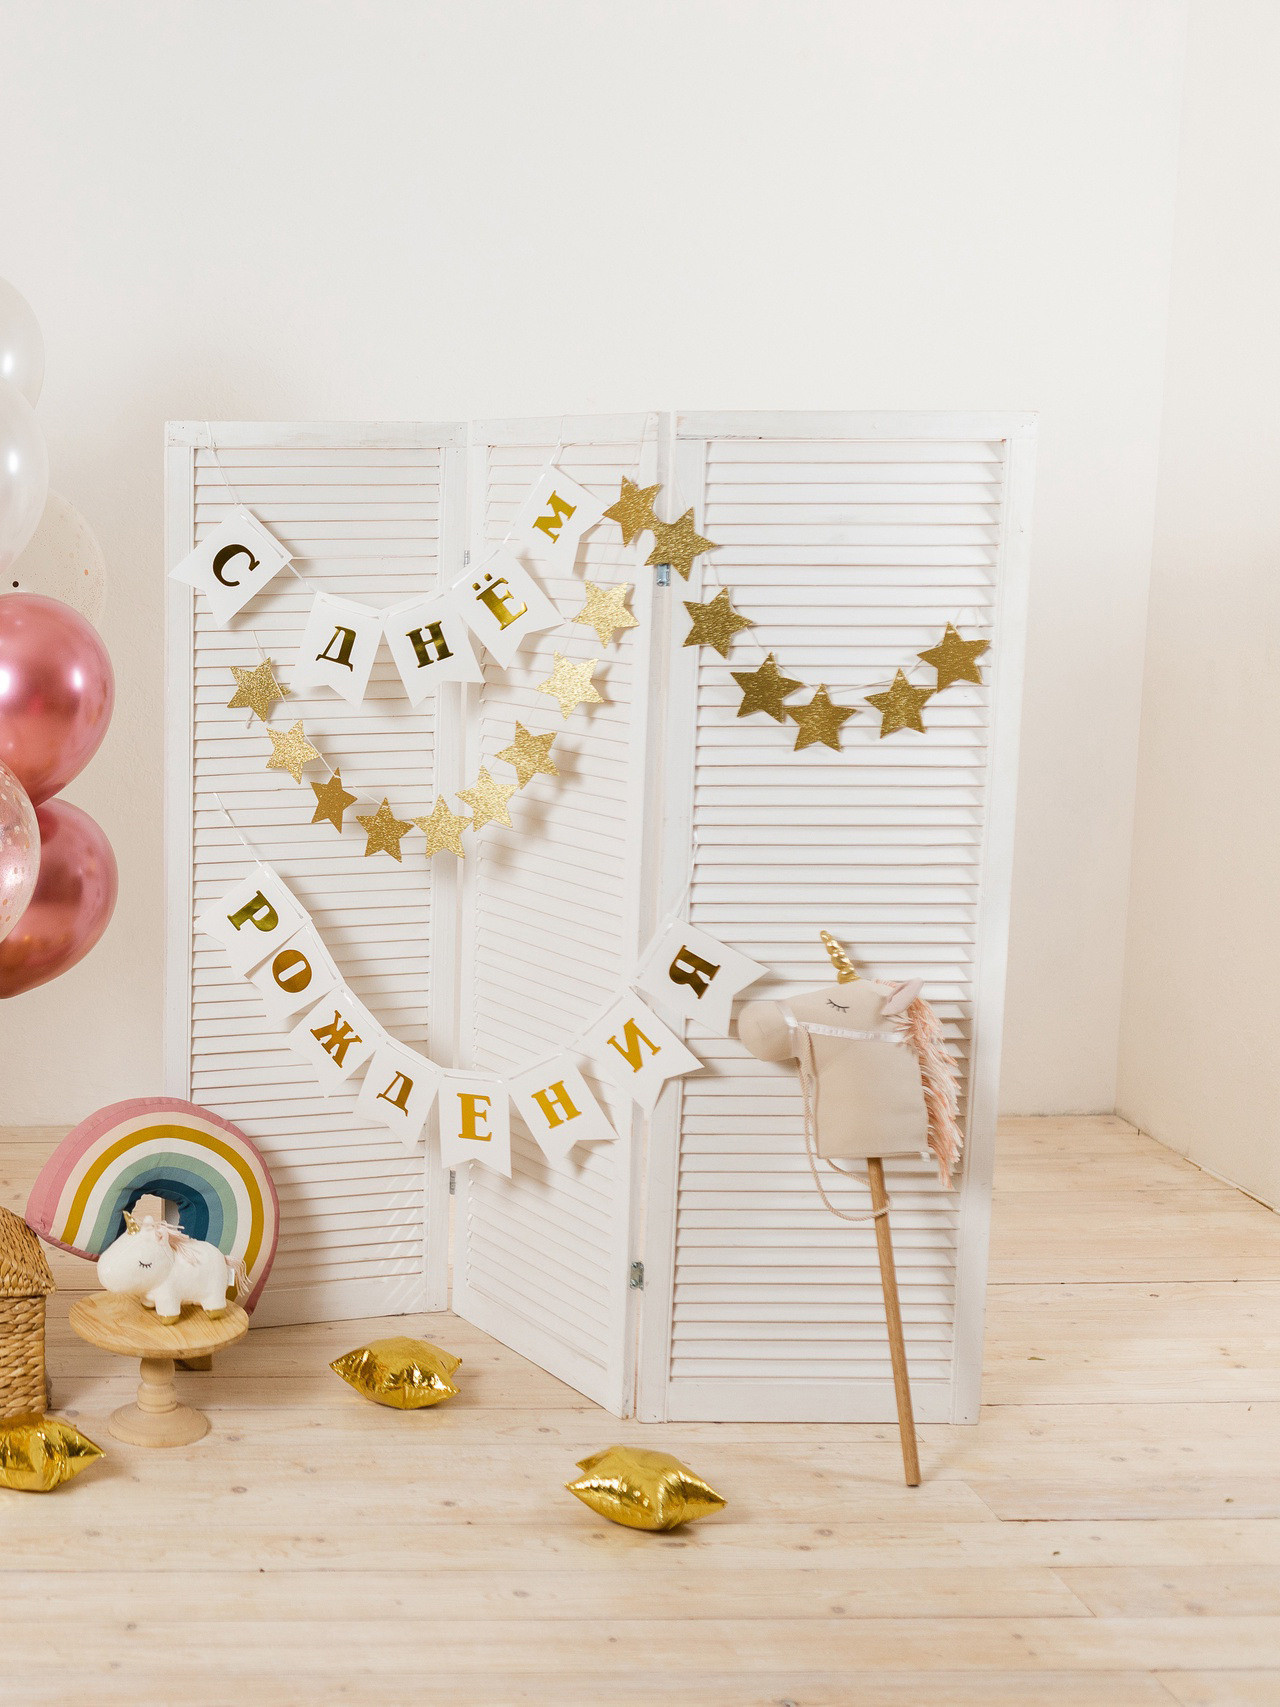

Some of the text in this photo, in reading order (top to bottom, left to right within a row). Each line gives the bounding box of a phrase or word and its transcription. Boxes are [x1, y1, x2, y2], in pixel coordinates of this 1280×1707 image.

[212, 489, 578, 673] С ДНЁМ
[226, 889, 722, 1142] РОЖДЕНИЯ
